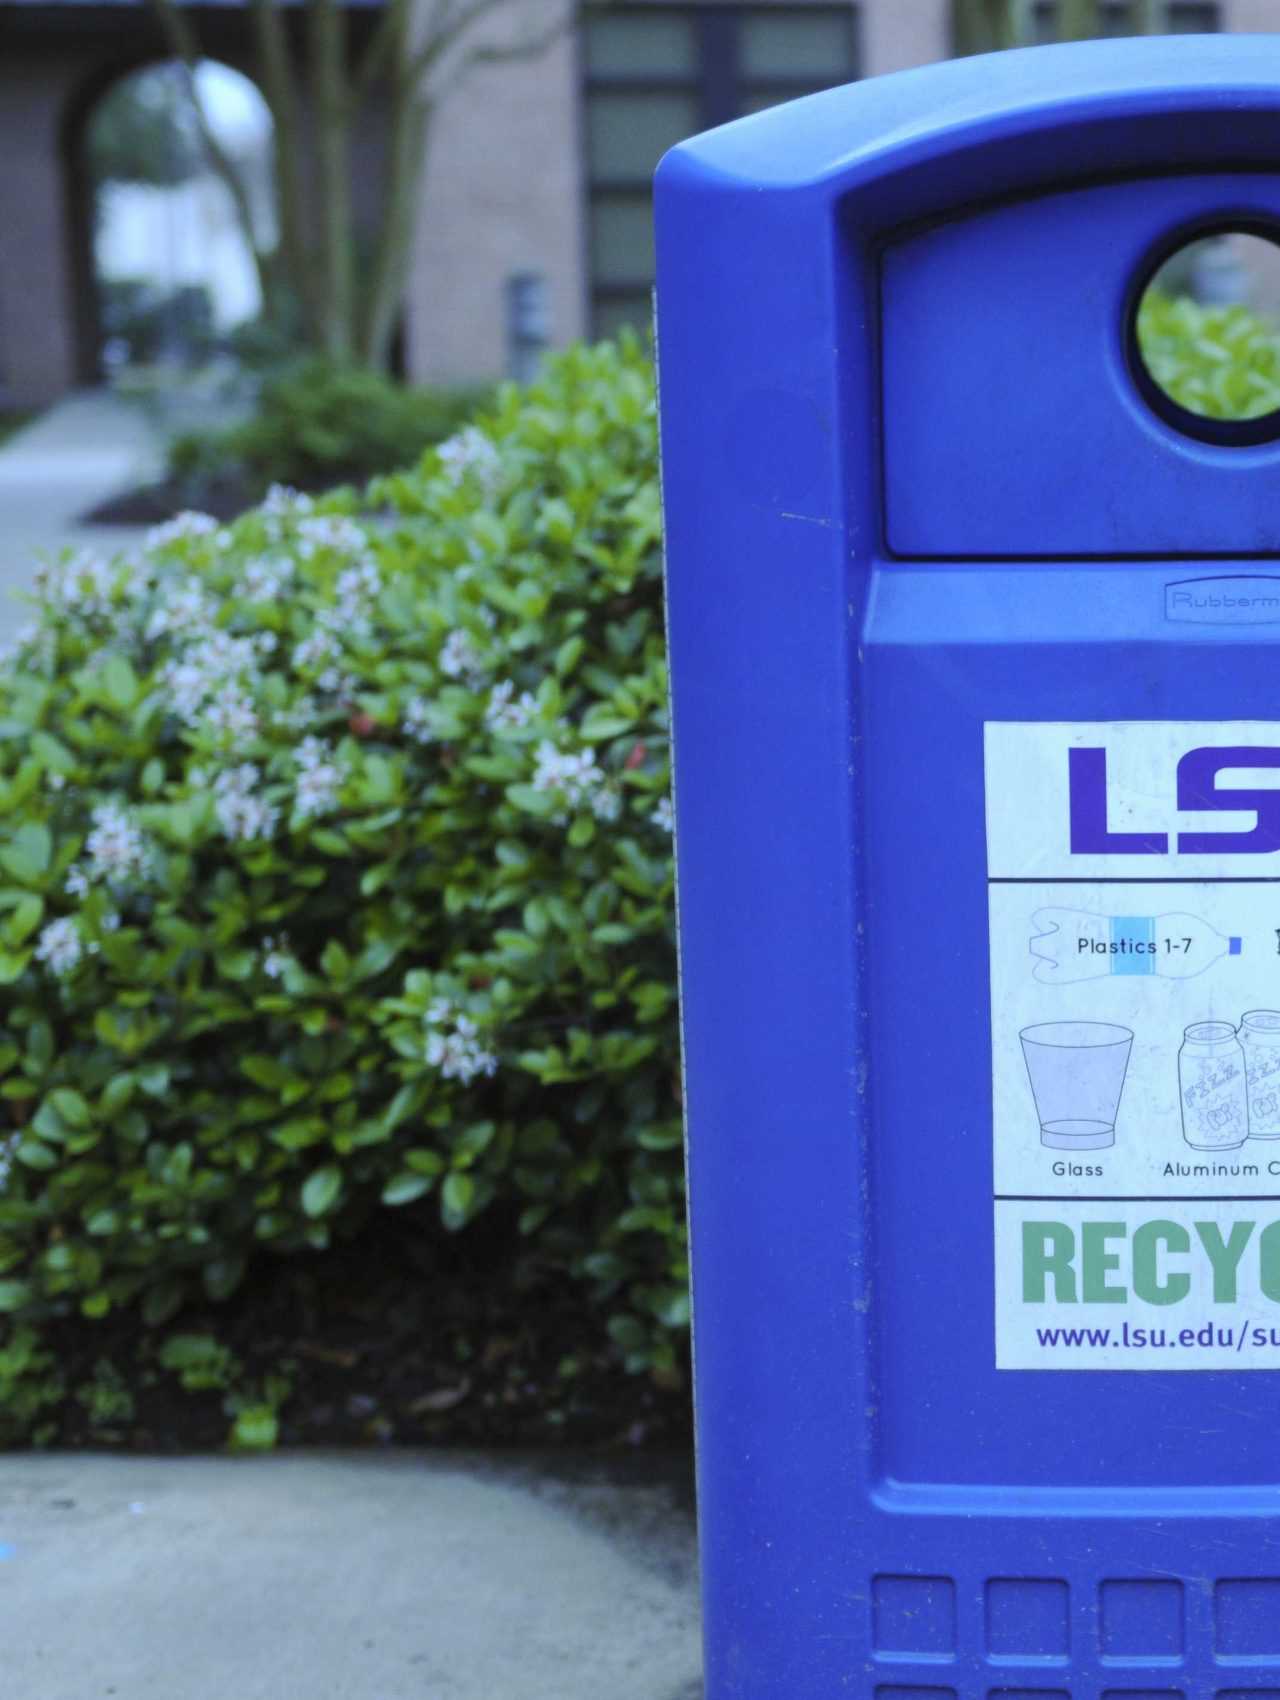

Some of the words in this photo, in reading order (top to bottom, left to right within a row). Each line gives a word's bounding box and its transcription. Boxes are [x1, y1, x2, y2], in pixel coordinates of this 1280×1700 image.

[1077, 937, 1156, 954] Plastics
[1164, 938, 1192, 954] 1-7
[1052, 1162, 1104, 1177] Glass
[1163, 1161, 1259, 1177] Aluminum
